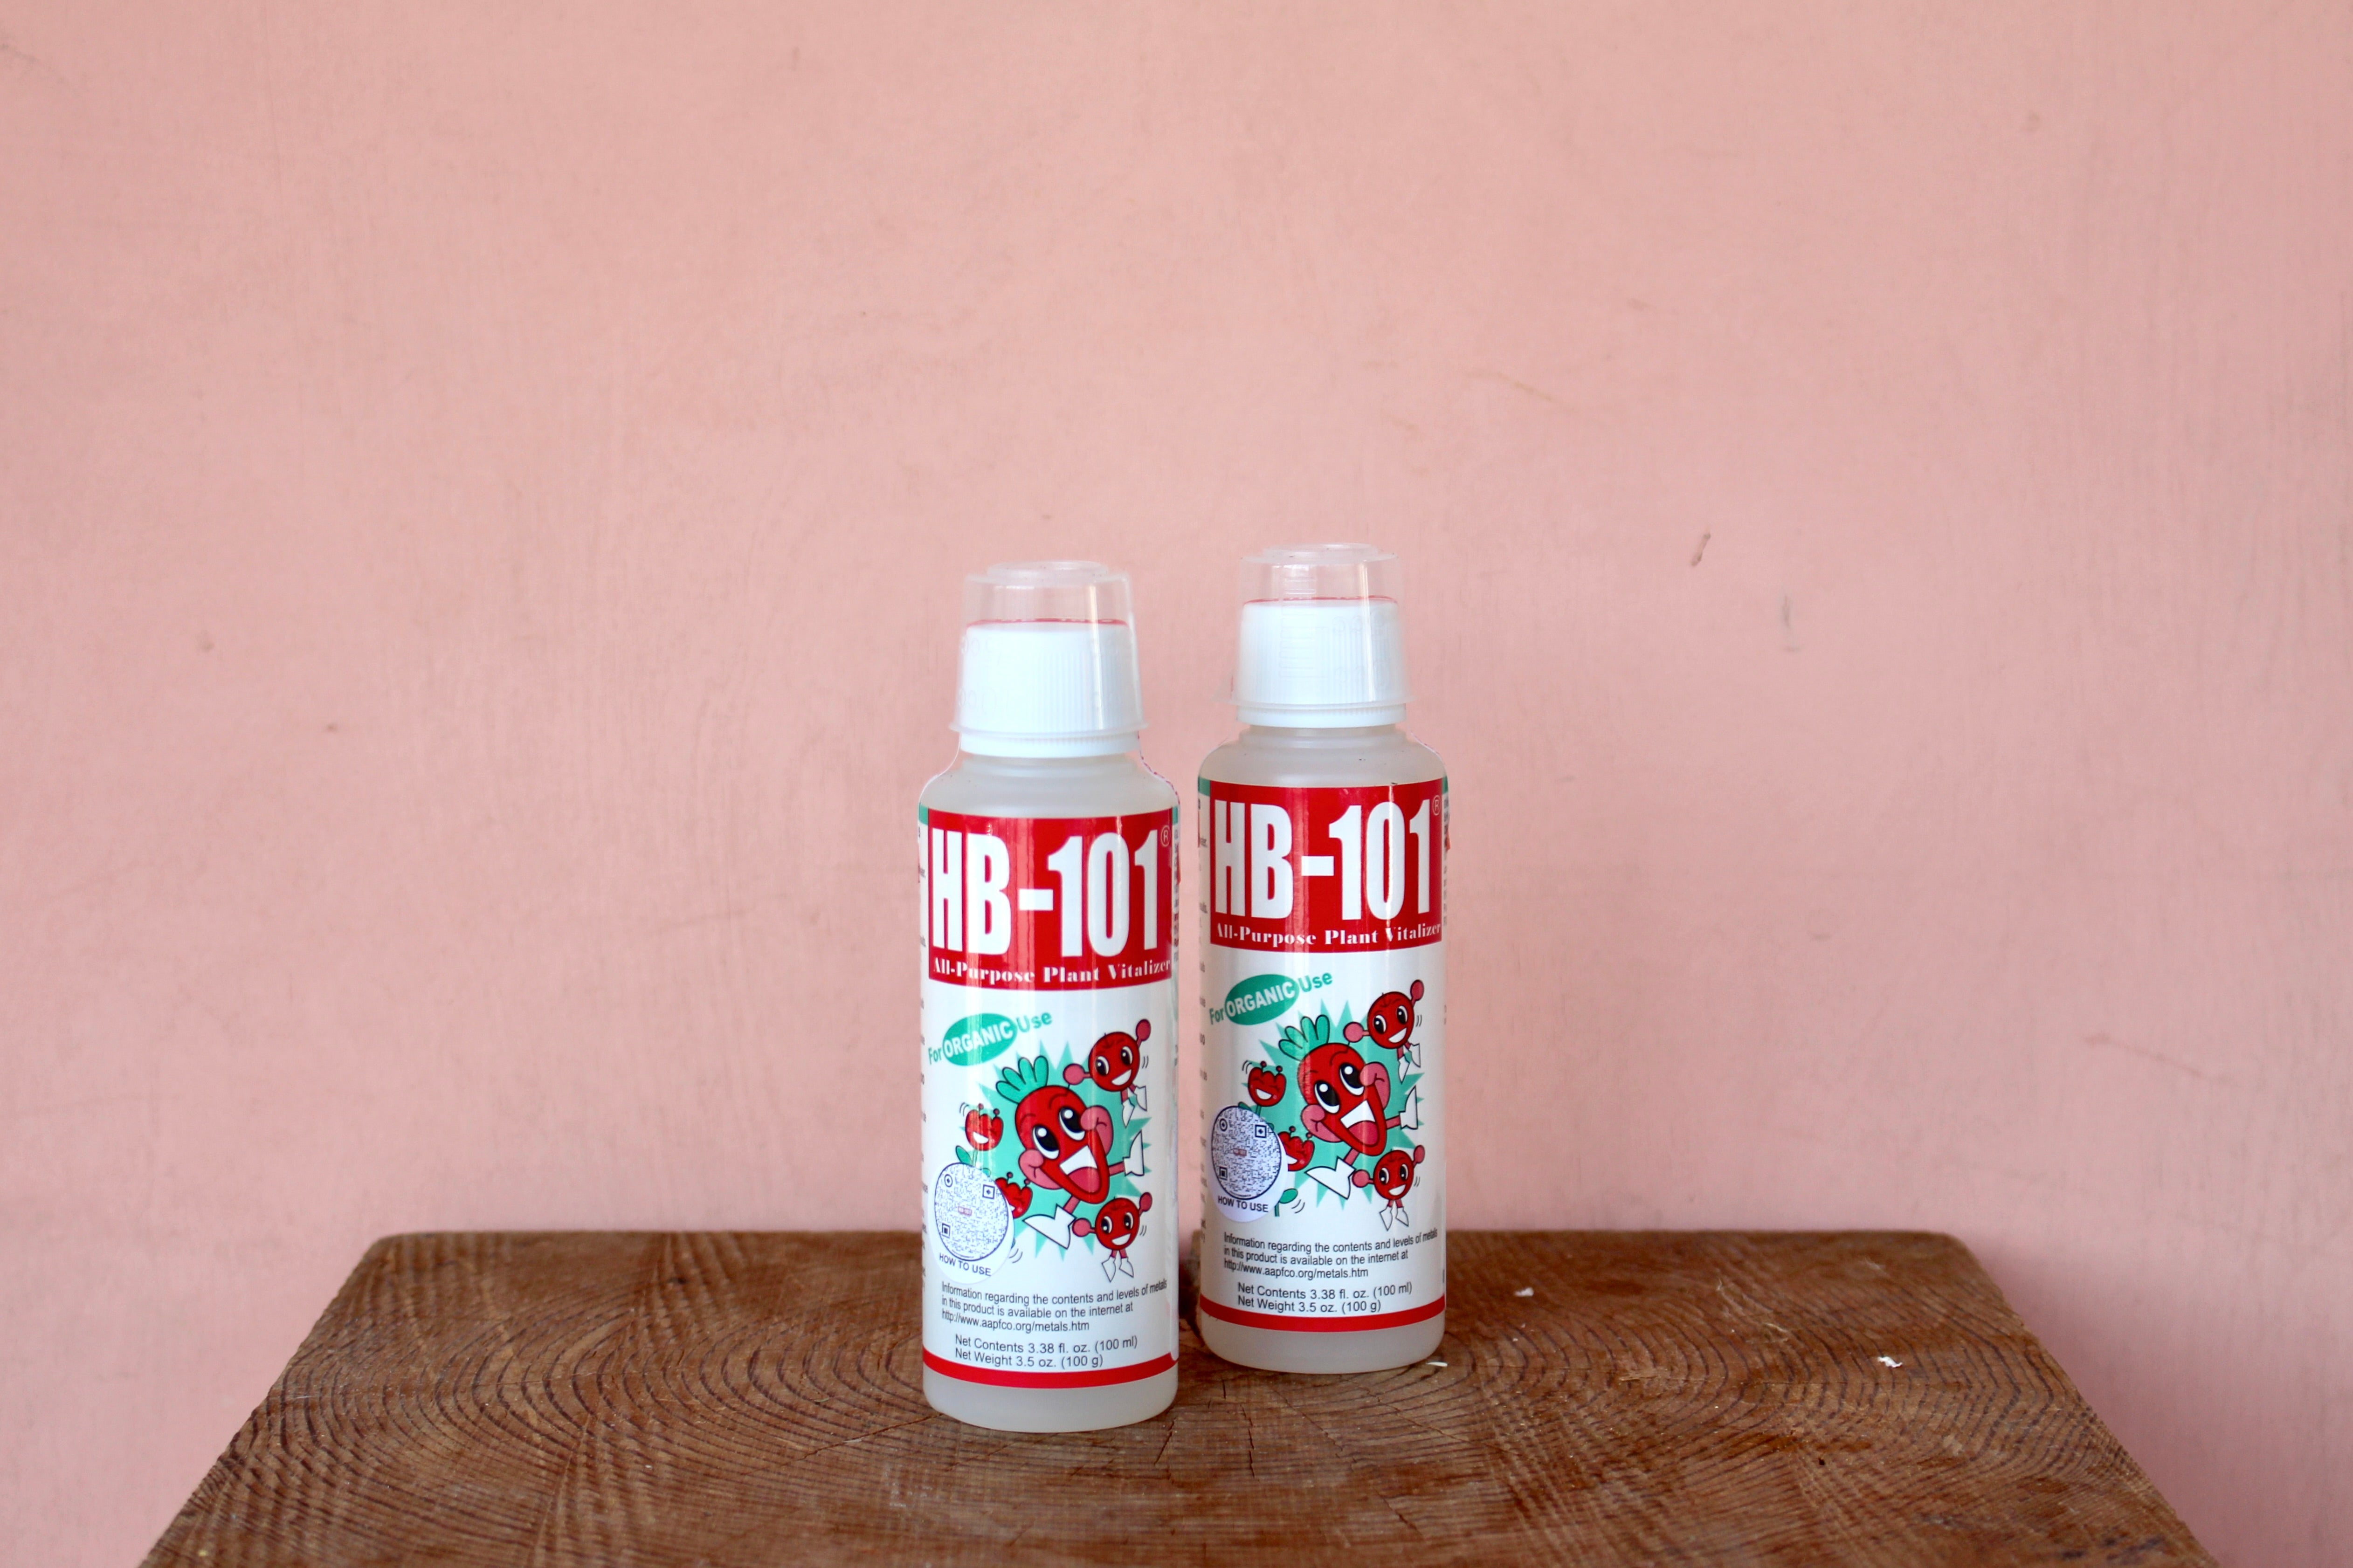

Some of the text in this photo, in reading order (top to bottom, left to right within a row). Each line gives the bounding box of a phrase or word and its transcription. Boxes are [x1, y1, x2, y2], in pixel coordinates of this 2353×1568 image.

[1214, 799, 1430, 920] HB-101
[932, 827, 1157, 957] HB-101
[1216, 922, 1441, 948] All-Purpose Plant Vitalizer
[933, 957, 1171, 985] All-Purpose Plant Vitalizer
[1209, 1008, 1225, 1025] For
[1225, 981, 1295, 1017] ORGANIC
[1300, 972, 1333, 992] Use
[928, 1045, 943, 1066] For
[943, 1020, 1014, 1058] ORGANIC
[1016, 1011, 1053, 1033] Use
[1217, 1195, 1234, 1207] HOW
[1236, 1200, 1247, 1209] TO
[1250, 1203, 1269, 1212] USE
[1224, 1228, 1437, 1254] Information regarding the contents and levels of metals
[939, 1252, 991, 1277] HOW TO USE
[1224, 1245, 1230, 1255] in
[1232, 1247, 1244, 1259] this
[1246, 1252, 1277, 1263] product
[1280, 1254, 1287, 1264] is
[1290, 1256, 1332, 1265] available
[1351, 1255, 1365, 1265] the
[1368, 1252, 1399, 1264] internet
[1401, 1249, 1408, 1259] at
[1224, 1258, 1368, 1280] http://www.aapfco.org/metals.htm
[942, 1279, 1167, 1307] Information regarding the contents and levels of metals
[1238, 1282, 1254, 1294] Net
[1257, 1286, 1306, 1299] Contents
[1310, 1289, 1335, 1299] 3.38
[1339, 1289, 1349, 1299] fl.
[1373, 1285, 1395, 1299] (100
[1399, 1281, 1412, 1295] ml)
[942, 1295, 1133, 1318] in this product is available on the internet at
[1238, 1295, 1254, 1307] Net
[1257, 1298, 1295, 1313] Weight
[1298, 1302, 1316, 1312] 3.5
[1342, 1301, 1366, 1314] (100
[1370, 1300, 1381, 1313] g)
[942, 1308, 1090, 1334] http://www.aapfco.org/metals.htm
[955, 1334, 1138, 1354] Net Contents 3.38 fl. oz. (100 ml)
[955, 1348, 971, 1361] Net
[974, 1352, 1012, 1367] Weight
[1016, 1356, 1035, 1367] 3.5
[1061, 1355, 1088, 1369] (100
[1091, 1355, 1103, 1368] g)
